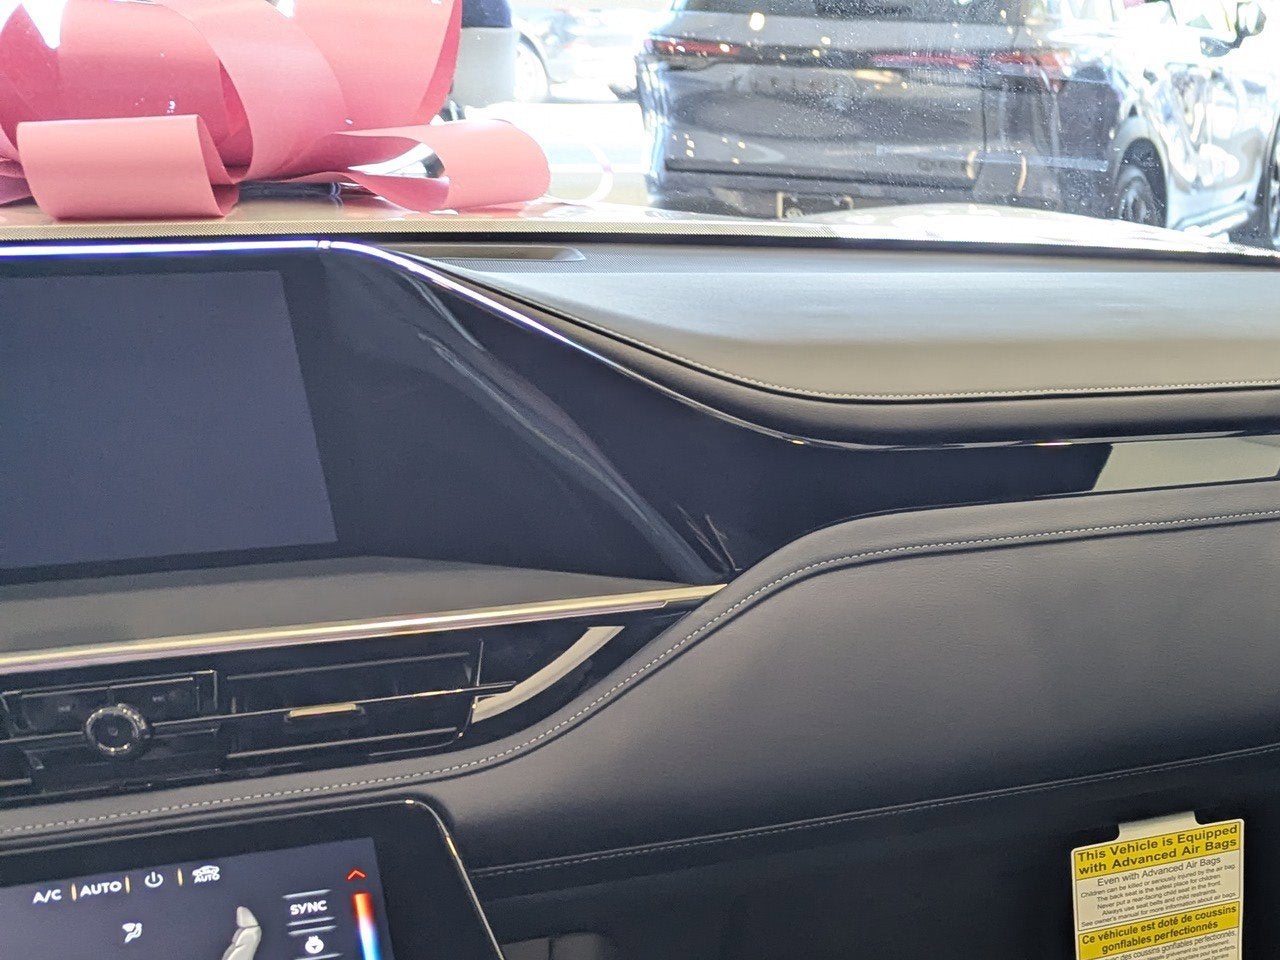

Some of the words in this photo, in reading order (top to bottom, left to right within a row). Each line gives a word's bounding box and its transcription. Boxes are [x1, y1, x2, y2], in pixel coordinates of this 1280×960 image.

[1078, 848, 1105, 861] This
[1109, 838, 1158, 856] Vehicle
[1162, 835, 1173, 846] is
[1177, 824, 1237, 845] Equipped
[1078, 861, 1106, 874] with
[1111, 848, 1176, 868] Advanced
[1181, 843, 1200, 855] Air
[1204, 836, 1236, 853] Bags
[194, 873, 221, 884] AUTO
[1097, 874, 1120, 886] Even
[1121, 871, 1139, 882] with
[1140, 862, 1184, 878] Advanced
[1185, 860, 1197, 869] Air
[1199, 855, 1221, 868] Bags
[32, 888, 62, 904] A/C
[80, 881, 122, 898] AUTO
[290, 900, 328, 915] SYNC
[1081, 933, 1095, 944] Ce
[1097, 924, 1138, 941] véhicule
[1140, 920, 1155, 932] est
[1157, 916, 1178, 928] doté
[1180, 913, 1192, 923] de
[1194, 903, 1236, 920] coussins
[1101, 933, 1151, 954] gonflables
[1153, 919, 1218, 943] perfectionnés
